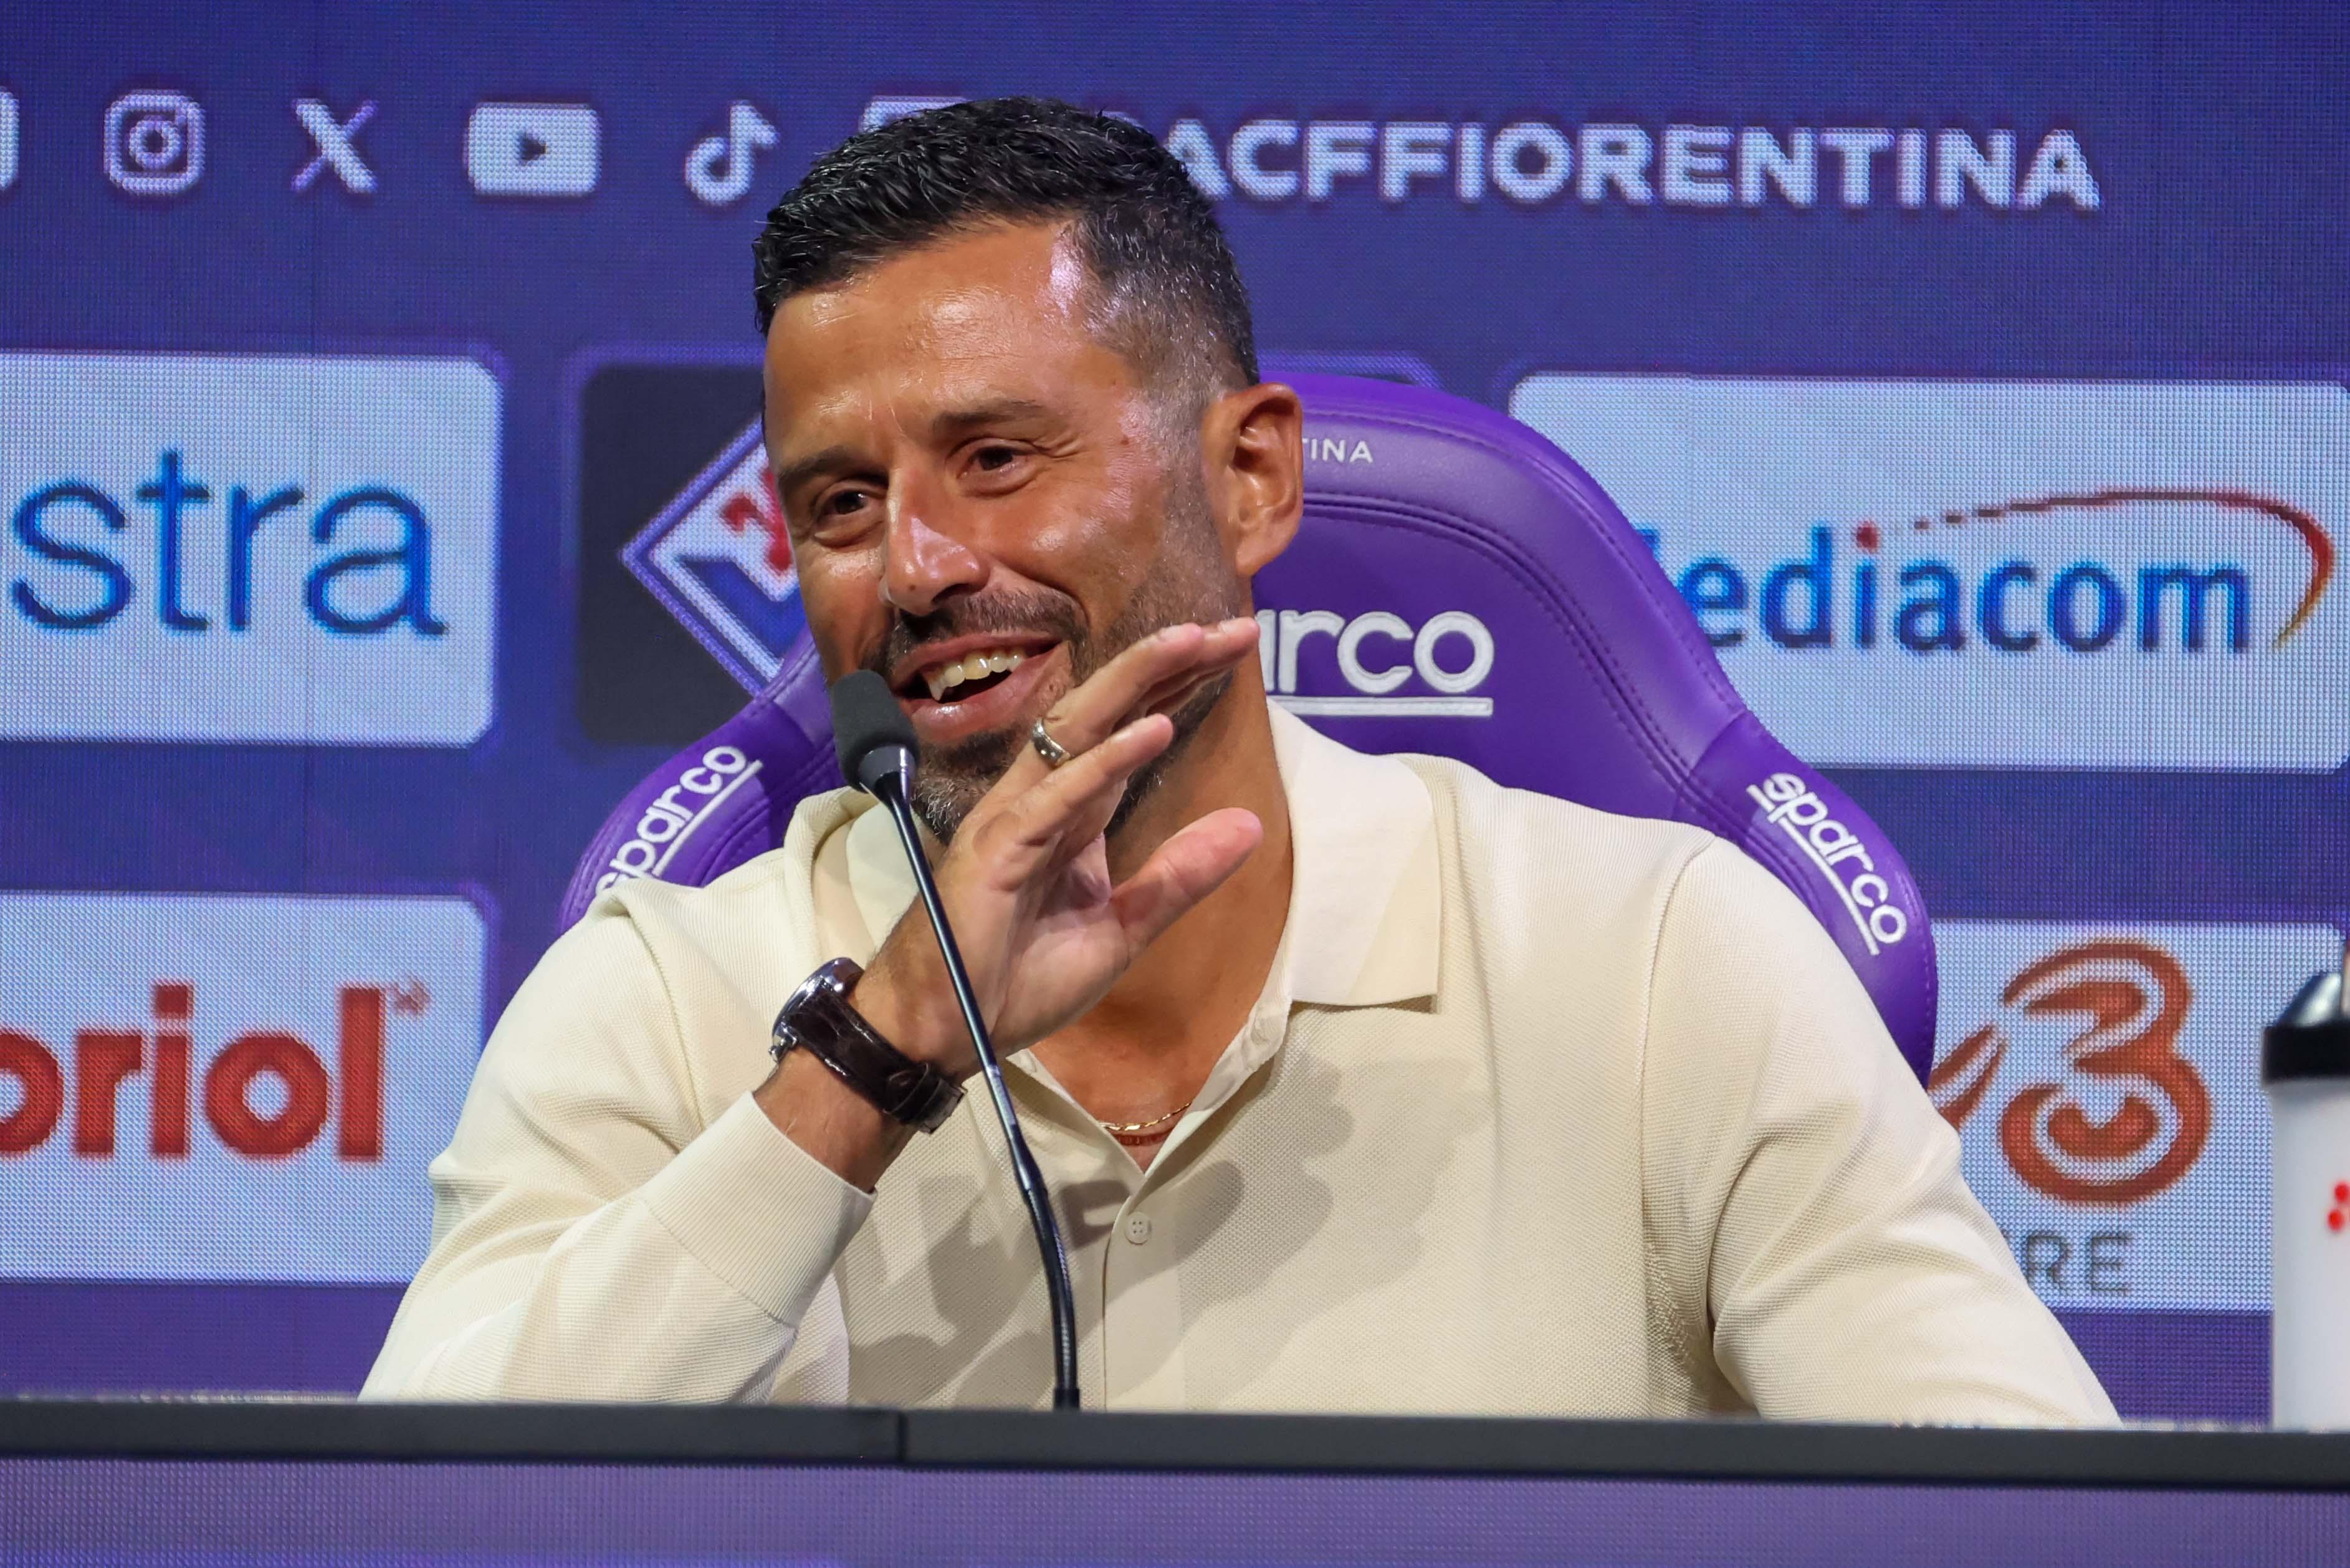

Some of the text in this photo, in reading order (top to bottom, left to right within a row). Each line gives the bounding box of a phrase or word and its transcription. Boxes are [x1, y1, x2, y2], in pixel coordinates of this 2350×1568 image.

[1100, 111, 2103, 211] ACFFIORENTINA
[1301, 437, 1373, 464] INA
[11, 447, 449, 637] stra
[1634, 521, 2251, 653] ediacom
[1255, 609, 1495, 694] rco
[1762, 772, 1908, 944] sparco
[2002, 1230, 2134, 1294] RE
